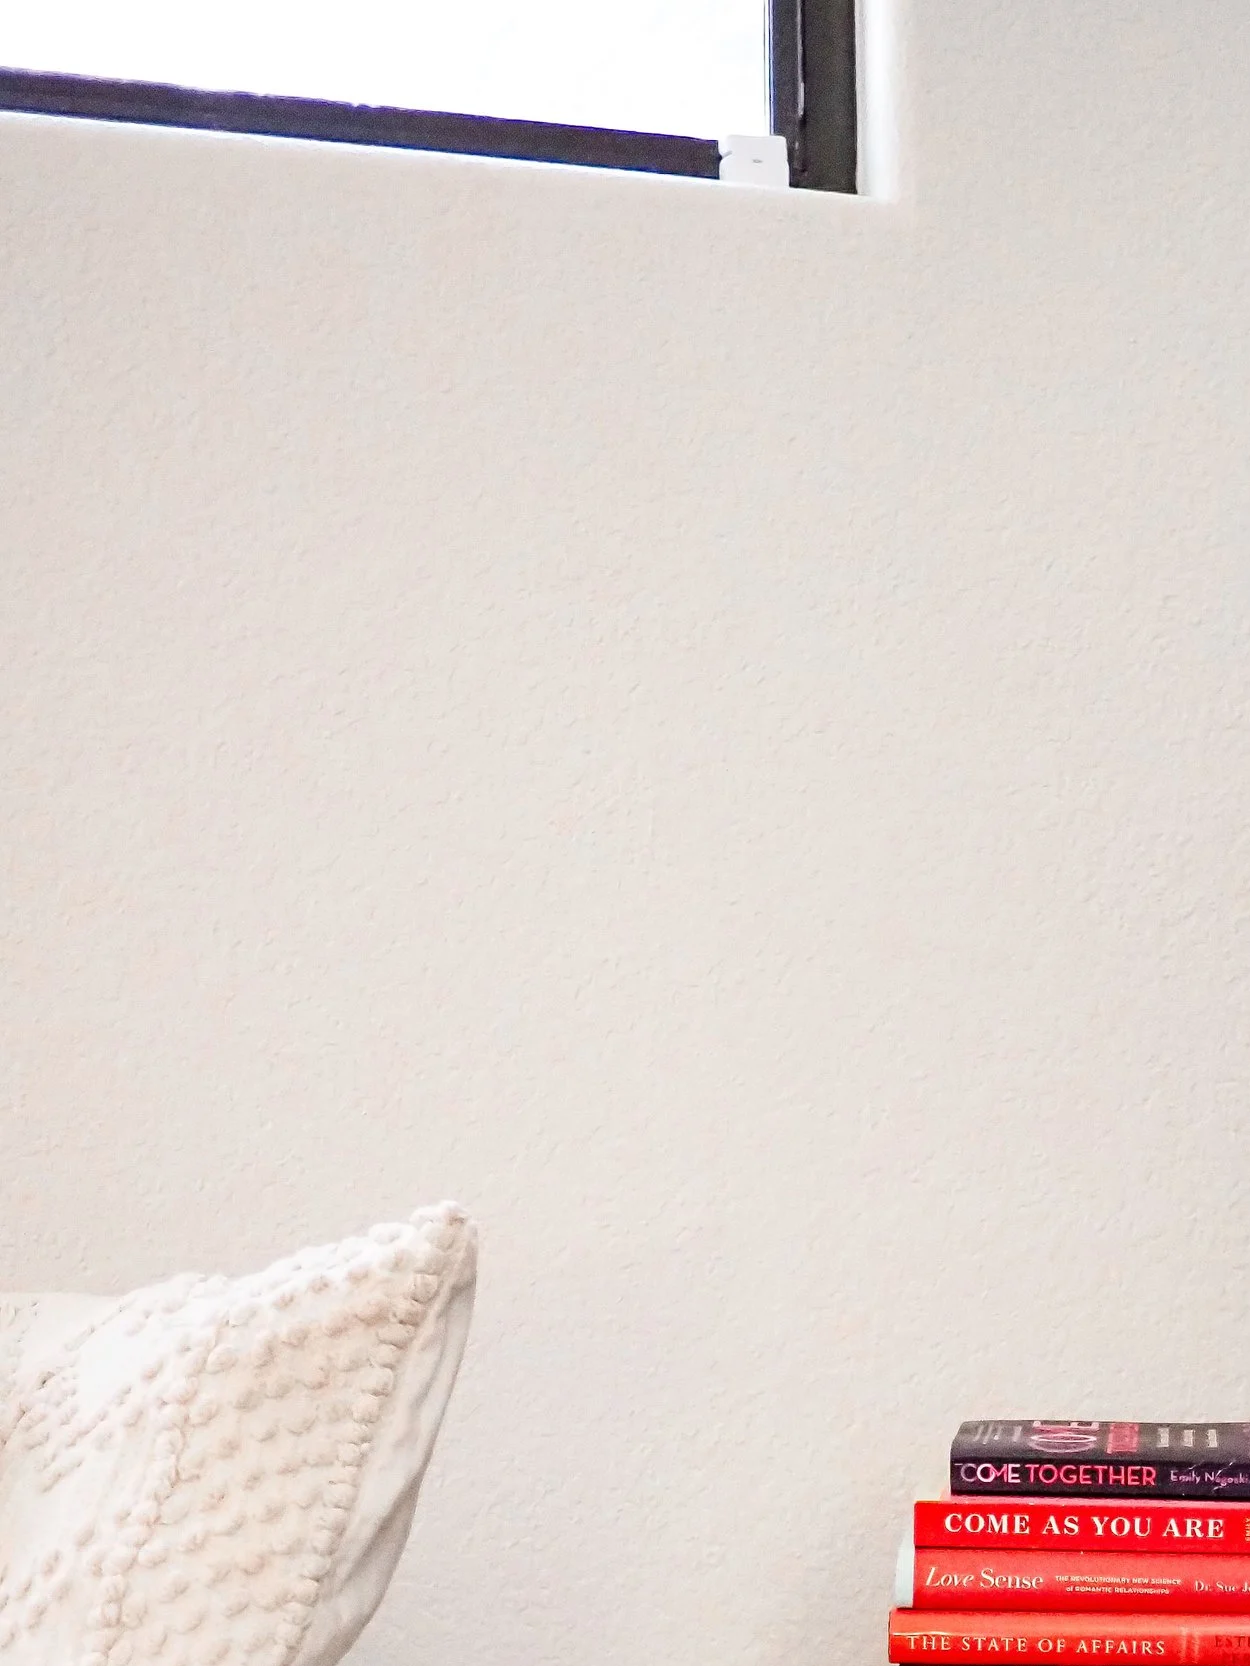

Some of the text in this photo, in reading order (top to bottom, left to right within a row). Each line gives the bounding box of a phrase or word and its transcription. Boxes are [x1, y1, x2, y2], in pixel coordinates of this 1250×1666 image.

[960, 1463, 1157, 1486] COME TOGETHER
[1170, 1470, 1201, 1484] Emily
[944, 1513, 1225, 1539] COME AS YOU ARE
[925, 1566, 1044, 1590] Love Sense
[1070, 1575, 1131, 1584] REVOLUTIONARY
[1194, 1580, 1213, 1593] Dr.
[1216, 1581, 1237, 1593] Sue
[1114, 1587, 1170, 1595] RELATIONSHIPS
[907, 1636, 1166, 1656] THE STATE OF AFFAIRS
